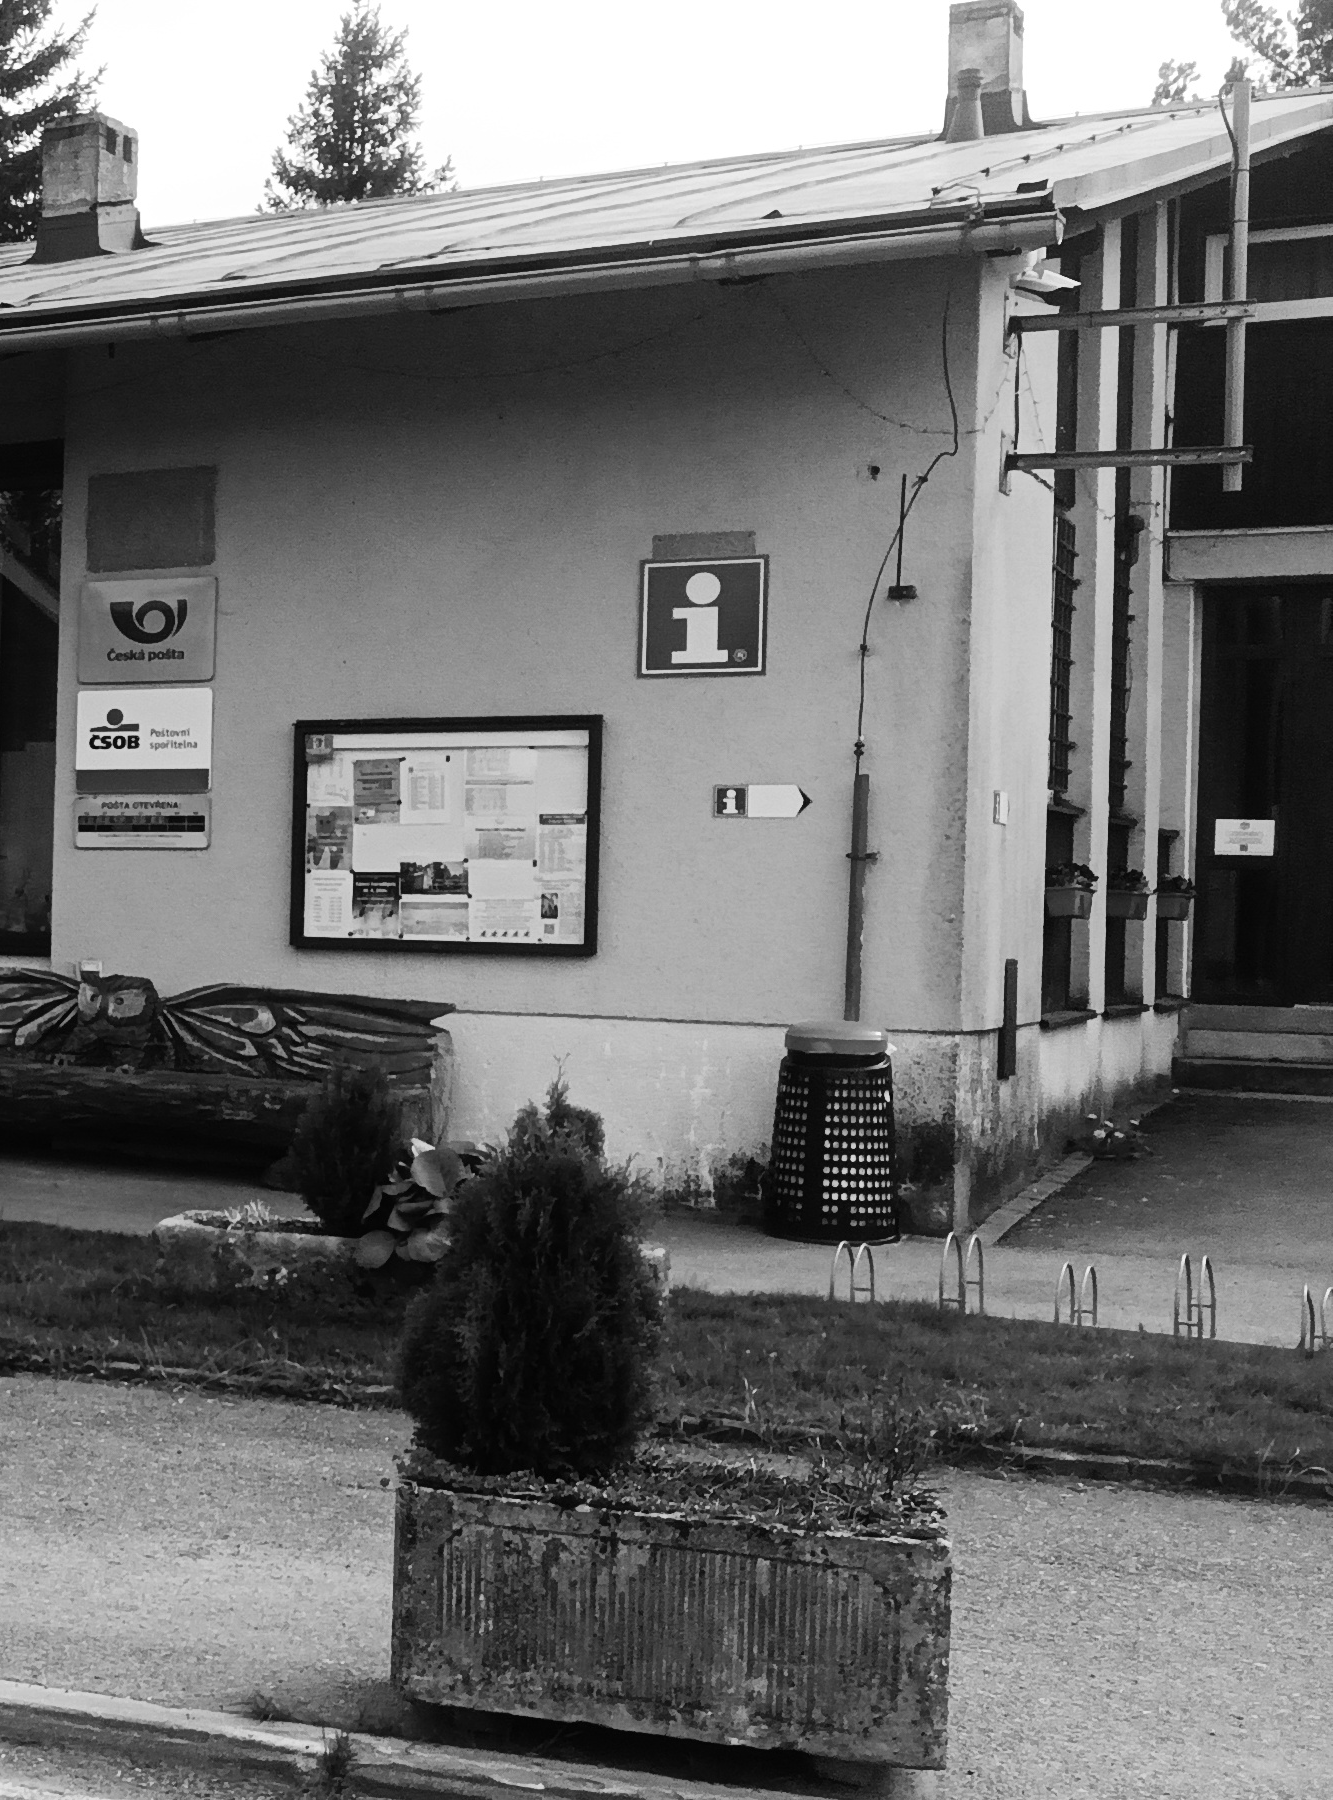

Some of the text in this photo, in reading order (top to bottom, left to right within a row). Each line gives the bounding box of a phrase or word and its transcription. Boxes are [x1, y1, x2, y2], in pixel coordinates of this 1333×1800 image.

[107, 648, 185, 662] Česká pošta
[150, 728, 191, 738] Poštovní
[89, 734, 140, 750] ČSOB
[149, 739, 198, 751] spořitelna
